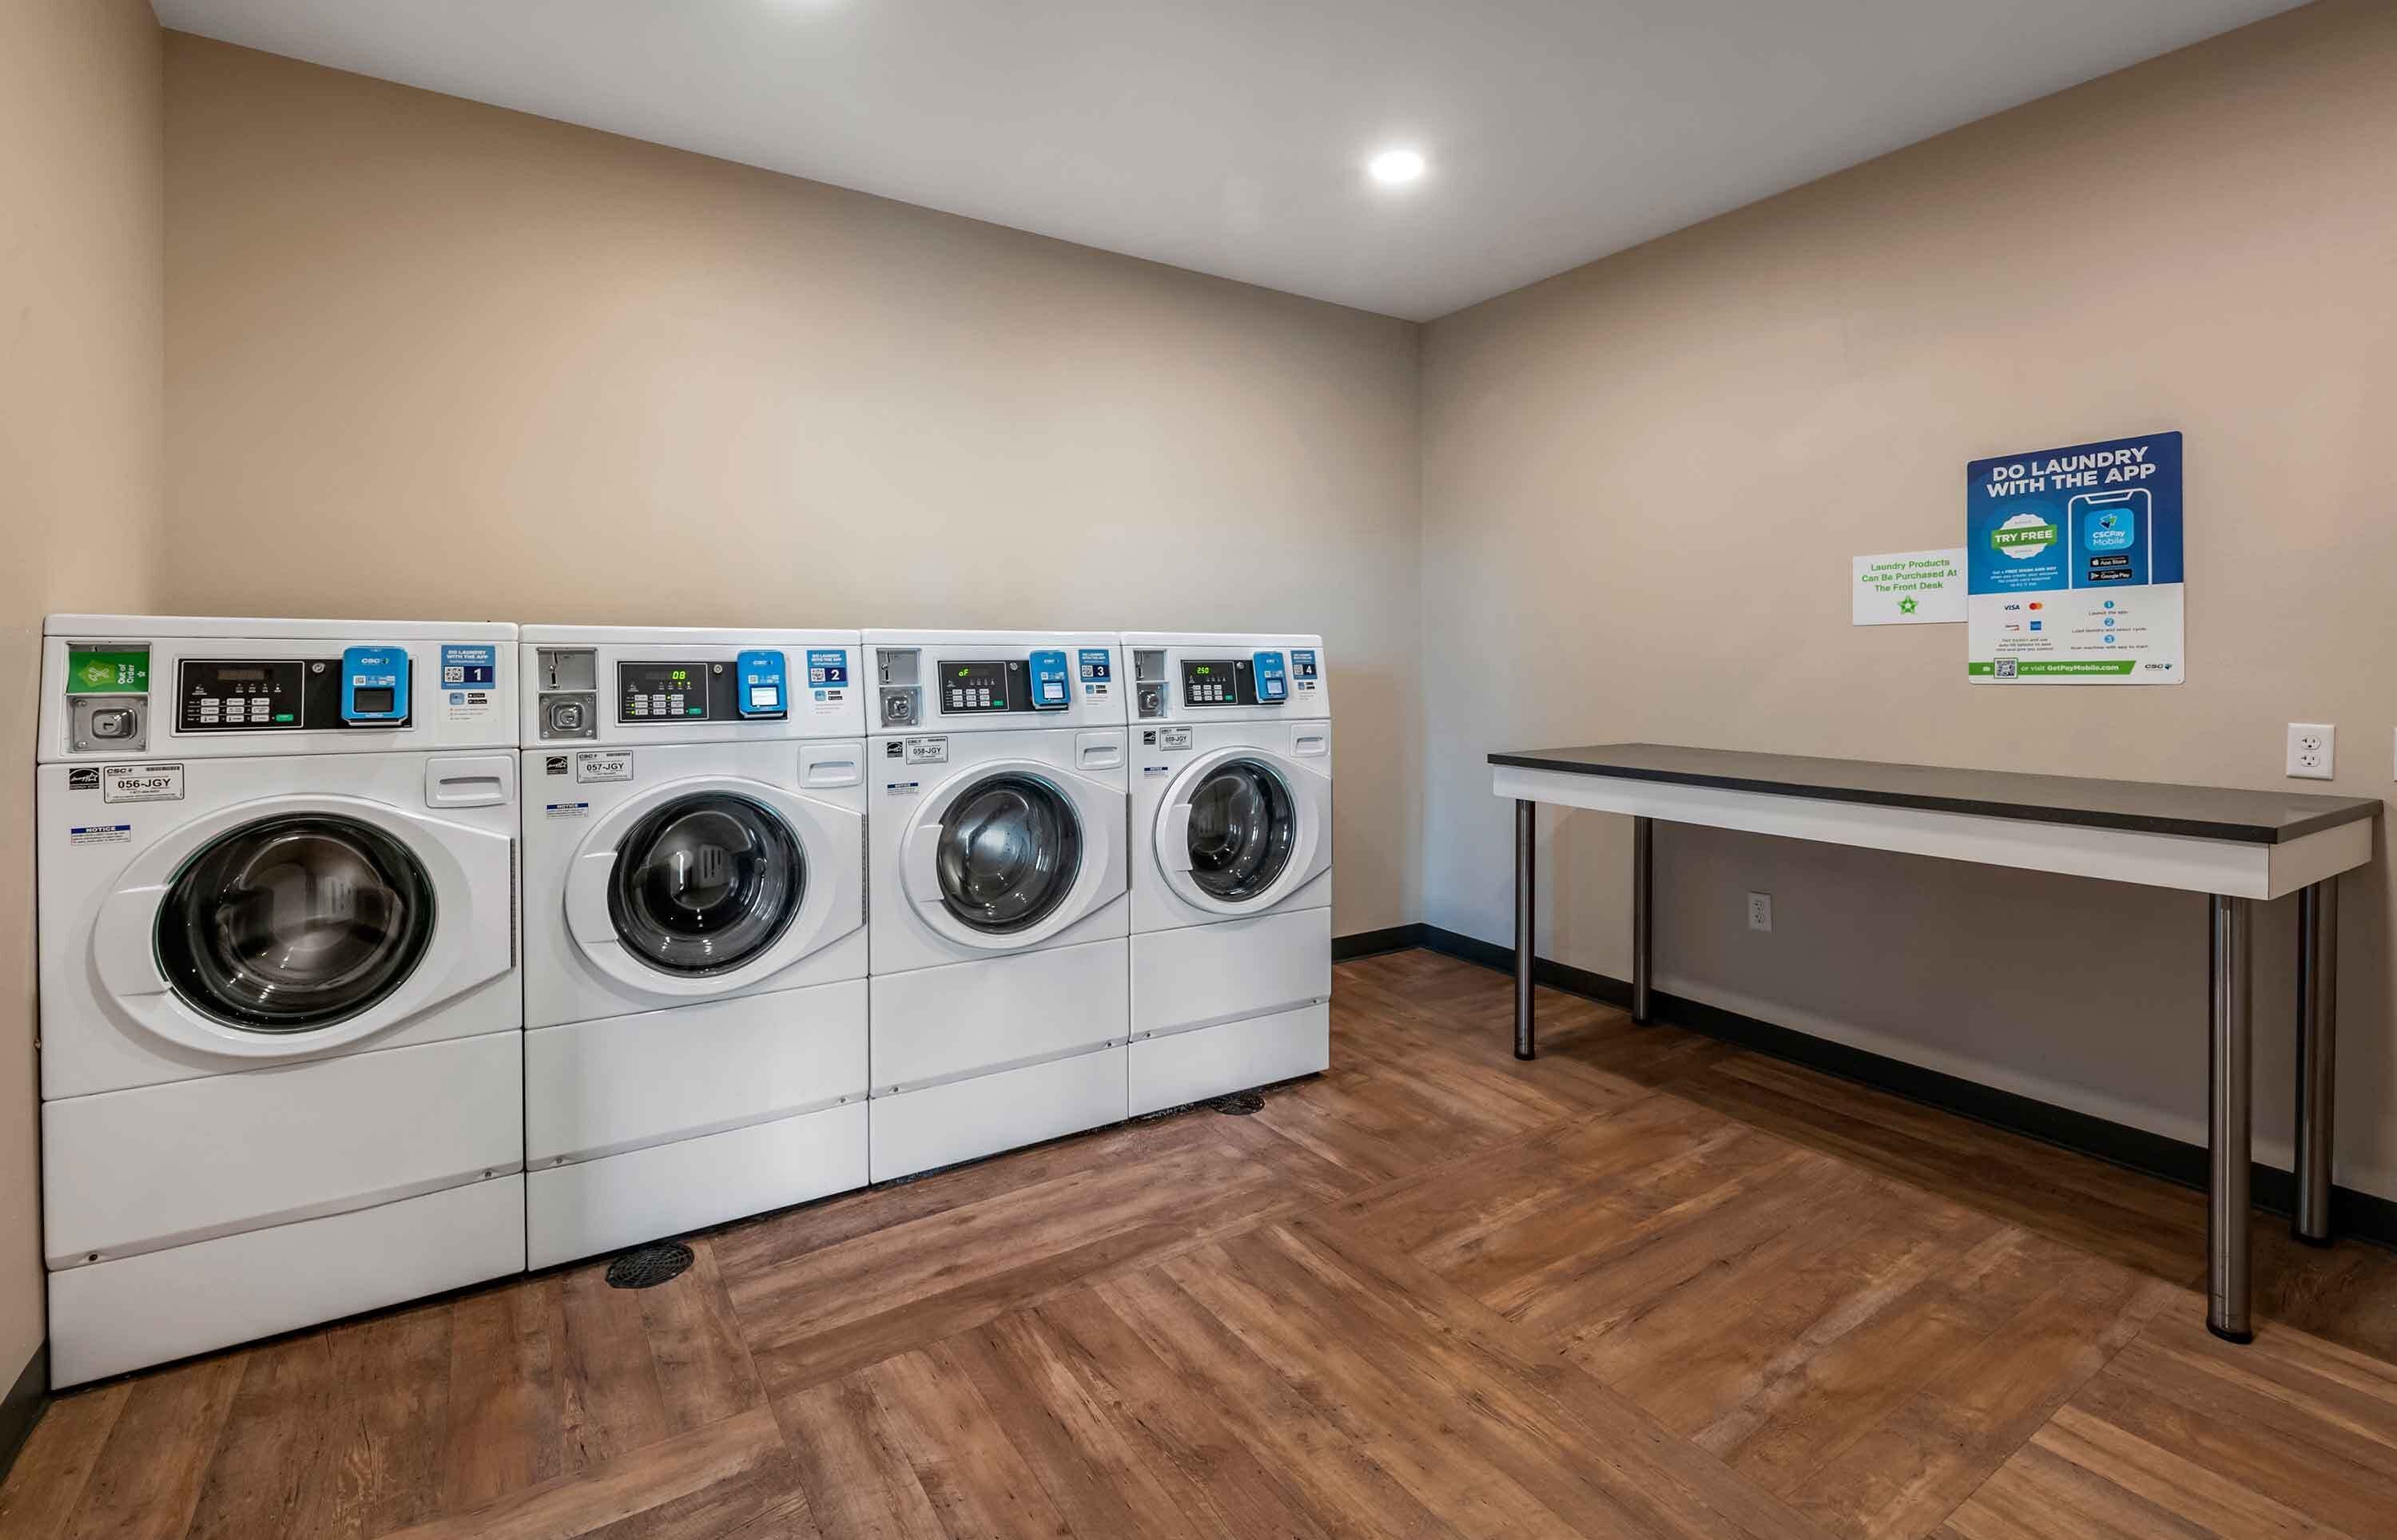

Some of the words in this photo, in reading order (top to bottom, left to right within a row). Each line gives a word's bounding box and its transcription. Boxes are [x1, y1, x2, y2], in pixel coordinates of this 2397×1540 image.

[1993, 465, 2025, 481] DO
[2032, 447, 2149, 475] LAUNDRY
[1986, 479, 2045, 498] WITH
[2051, 470, 2098, 489] THE
[2105, 463, 2157, 483] APP
[1994, 533, 2017, 543] TRY
[2021, 530, 2053, 541] FREE
[1870, 562, 1906, 572] Laundry
[1909, 559, 1950, 569] Products
[1895, 570, 1944, 580] Purchased
[474, 668, 481, 681] 1
[1097, 665, 1104, 677] 3
[1306, 665, 1312, 674] 4
[2047, 664, 2119, 673] GetPayMobile.com
[117, 671, 126, 685] Out
[672, 670, 686, 680] 08
[831, 669, 840, 681] 2
[586, 762, 624, 772] 057-JGY
[117, 778, 171, 789] 056-JGY
